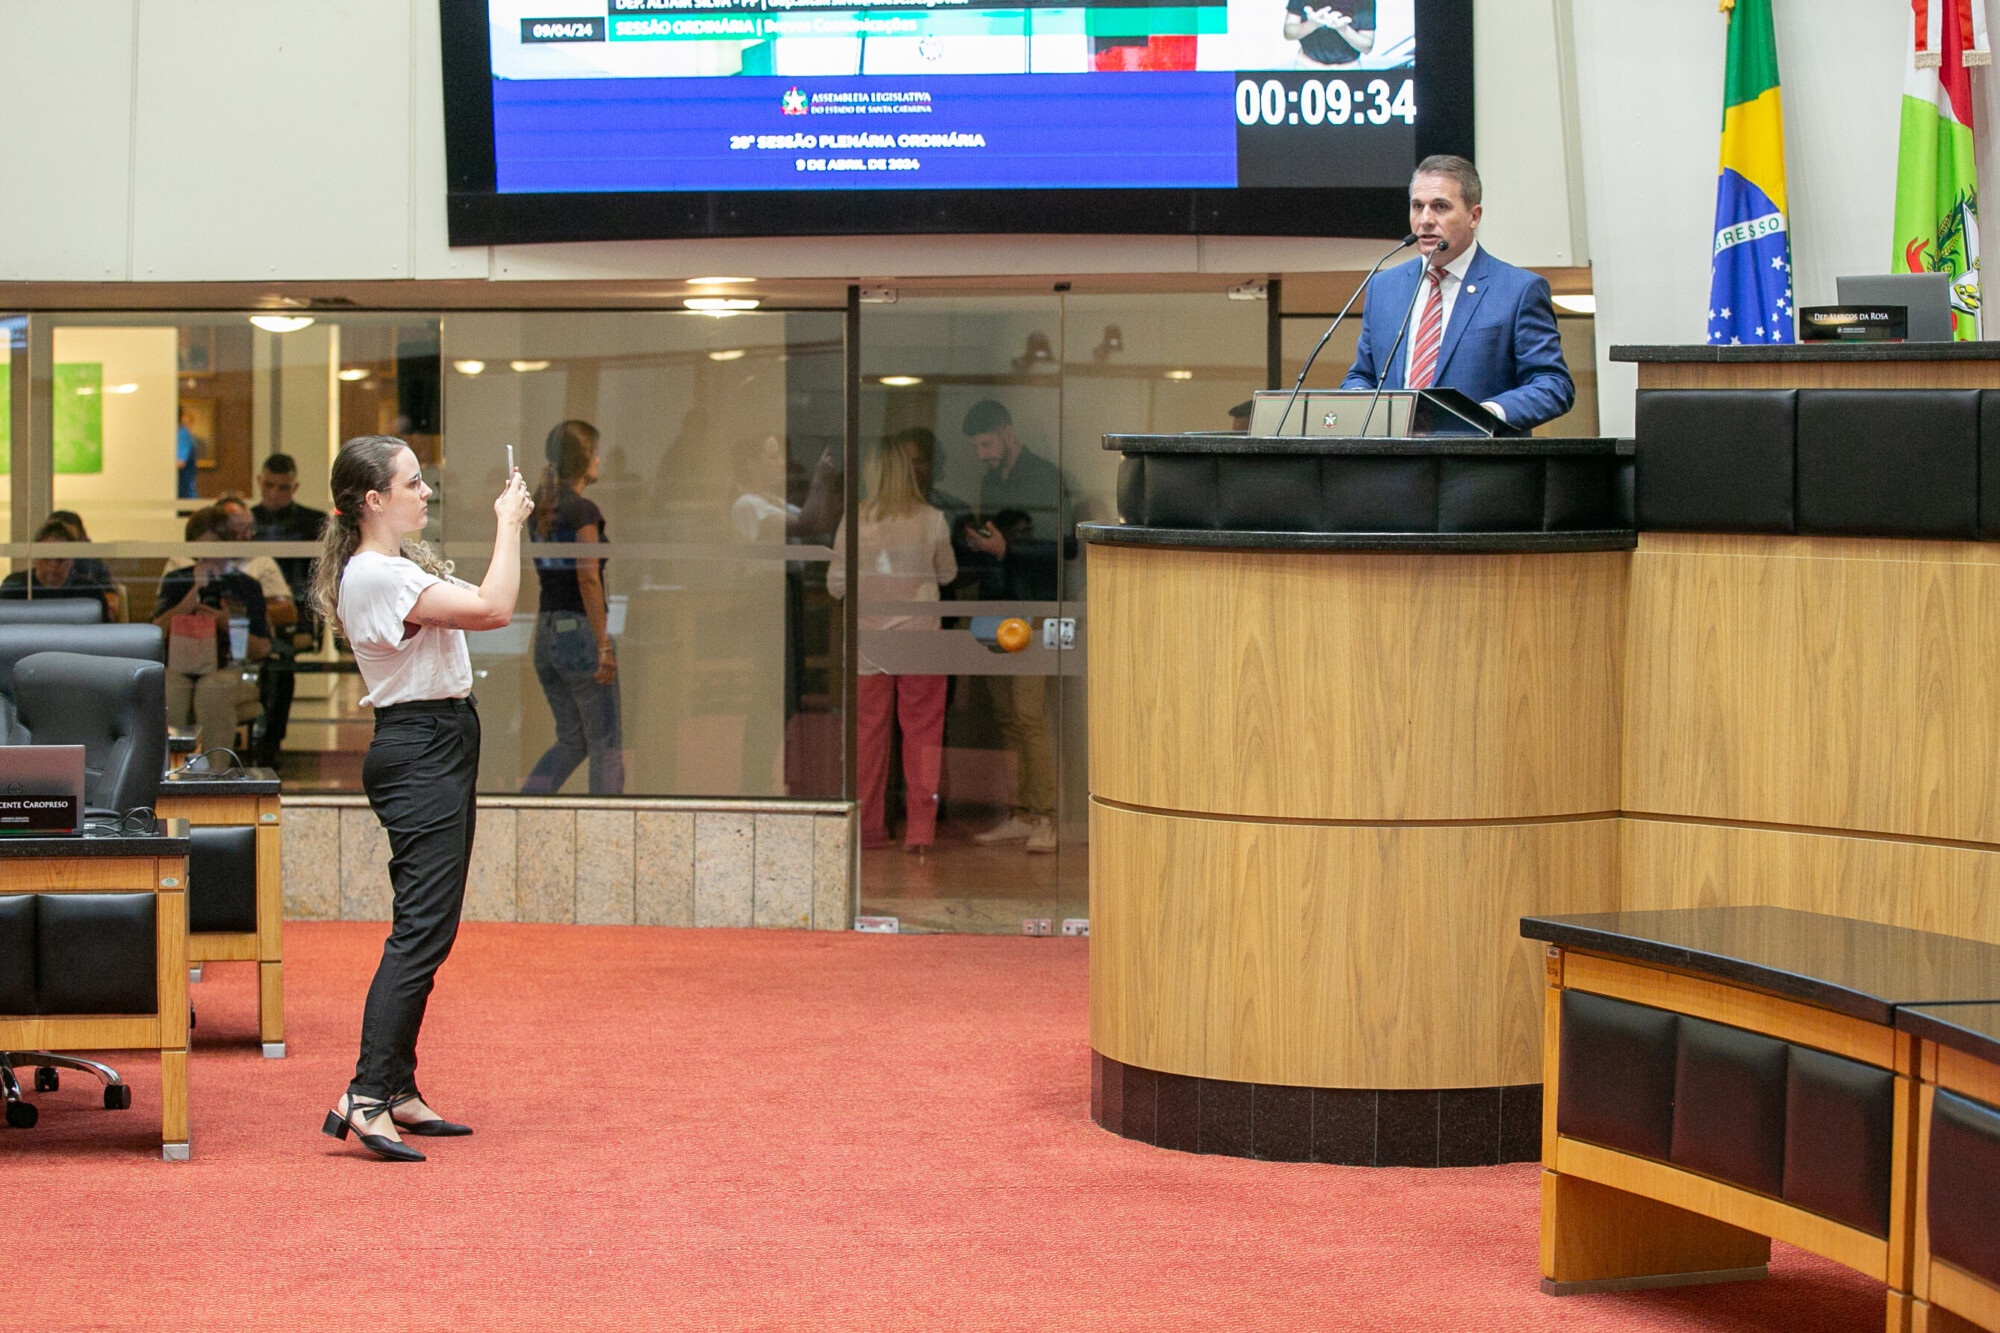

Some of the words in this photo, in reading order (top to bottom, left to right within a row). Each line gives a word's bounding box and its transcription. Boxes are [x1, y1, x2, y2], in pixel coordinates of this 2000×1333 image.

[533, 23, 593, 38] 09/04/24
[615, 19, 671, 35] SESSÃO
[672, 18, 755, 34] ORDINÁRIA
[811, 93, 869, 103] ASSEMBLEIA
[871, 92, 931, 102] LEGISLATIVA
[1235, 79, 1417, 125] 00:09:34
[811, 106, 824, 114] DO
[825, 106, 855, 114] ESTADO
[856, 106, 866, 114] DE
[868, 105, 892, 113] SANTA
[893, 105, 932, 113] CATARINA
[757, 133, 817, 149] SESSÃO
[819, 132, 896, 148] PLENÁRIA
[897, 132, 986, 147] ORDINÁRIA
[796, 159, 806, 171] 9
[807, 159, 826, 171] DE
[827, 159, 867, 170] ABRIL
[868, 159, 887, 170] DE
[888, 158, 920, 170] 2024
[1870, 312, 1889, 321] ROSA
[23, 800, 68, 809] CAROPRESO
